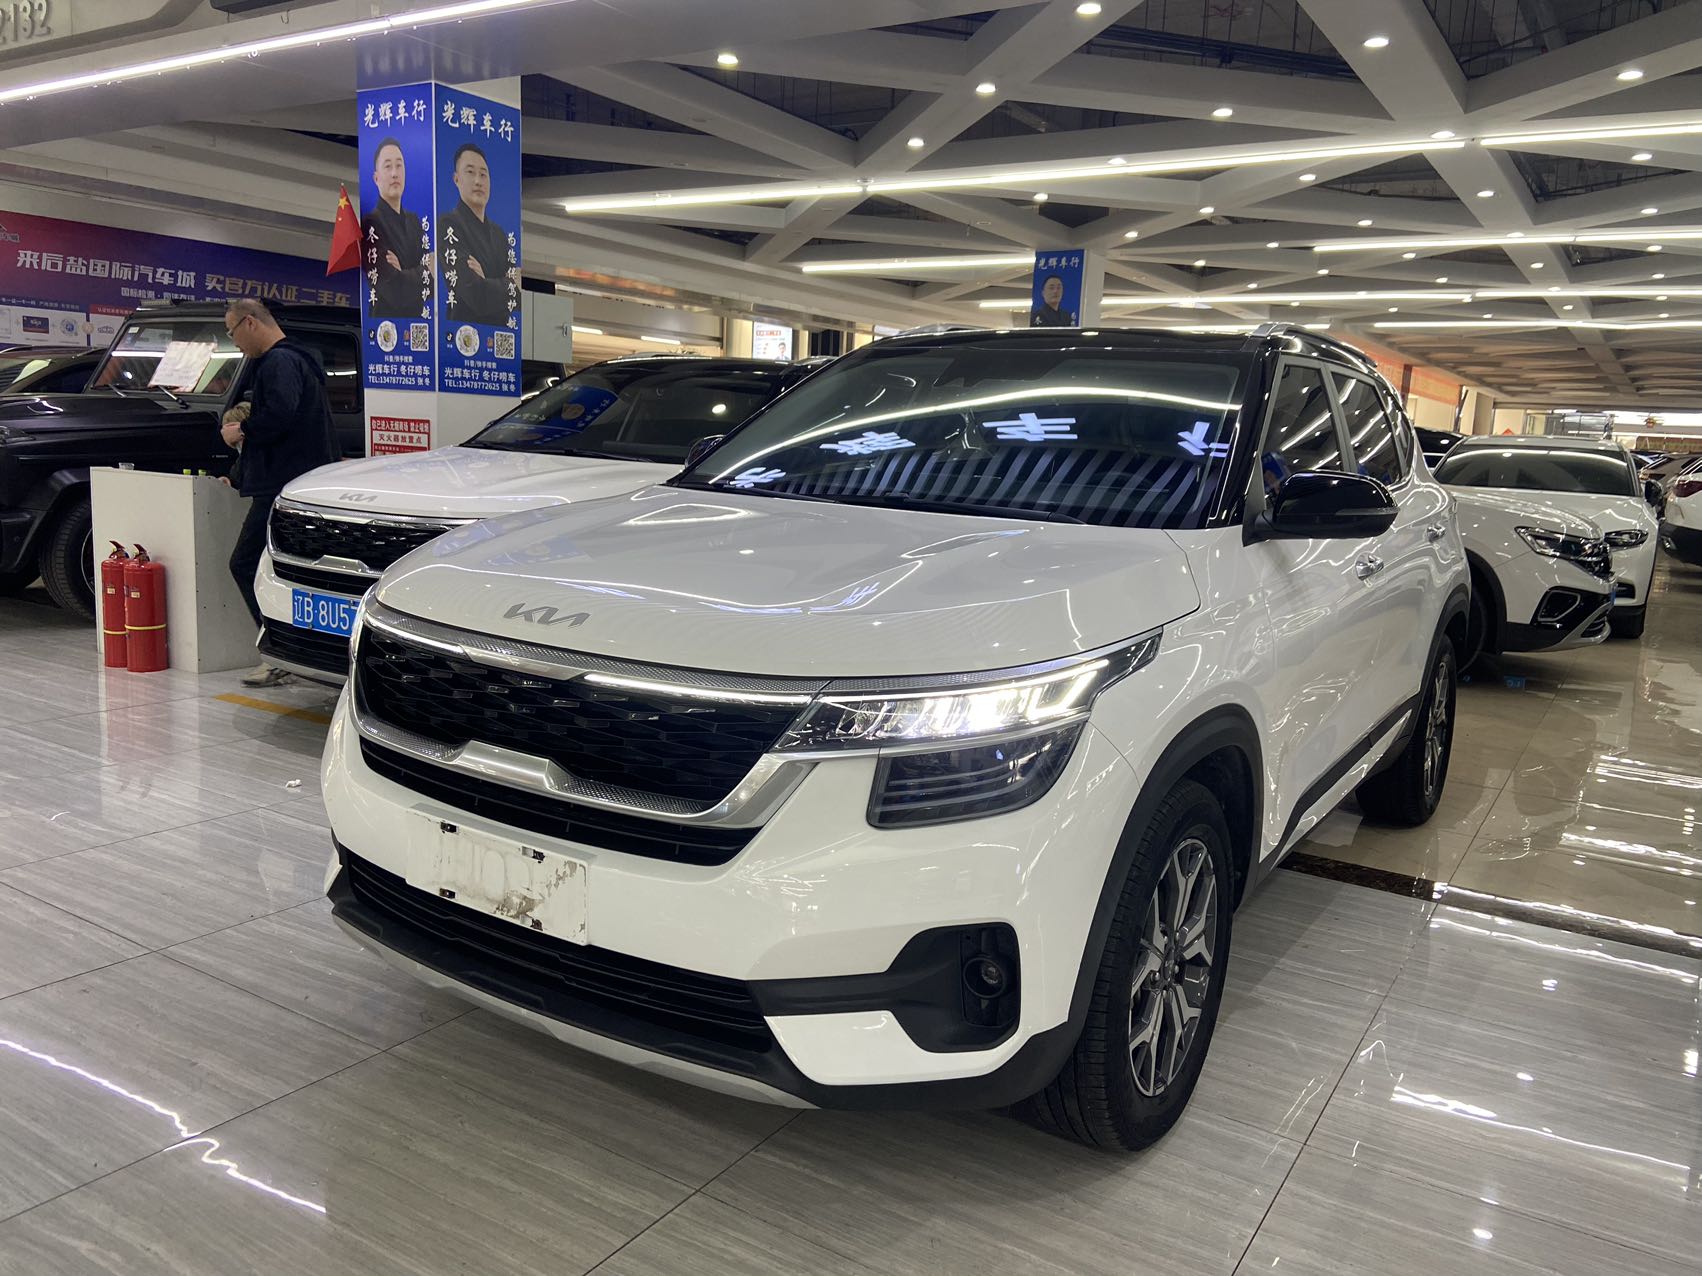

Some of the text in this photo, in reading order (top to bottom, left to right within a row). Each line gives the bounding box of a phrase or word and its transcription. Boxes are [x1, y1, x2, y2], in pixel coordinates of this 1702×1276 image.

[364, 99, 427, 128] 光辉车行
[442, 100, 514, 142] 光辉车行
[17, 249, 351, 307] 来后盐国际汽车城 买官方认证二手车
[368, 363, 398, 375] 光辉车行
[445, 367, 480, 380] 光辉车行
[503, 602, 591, 627] KIA
